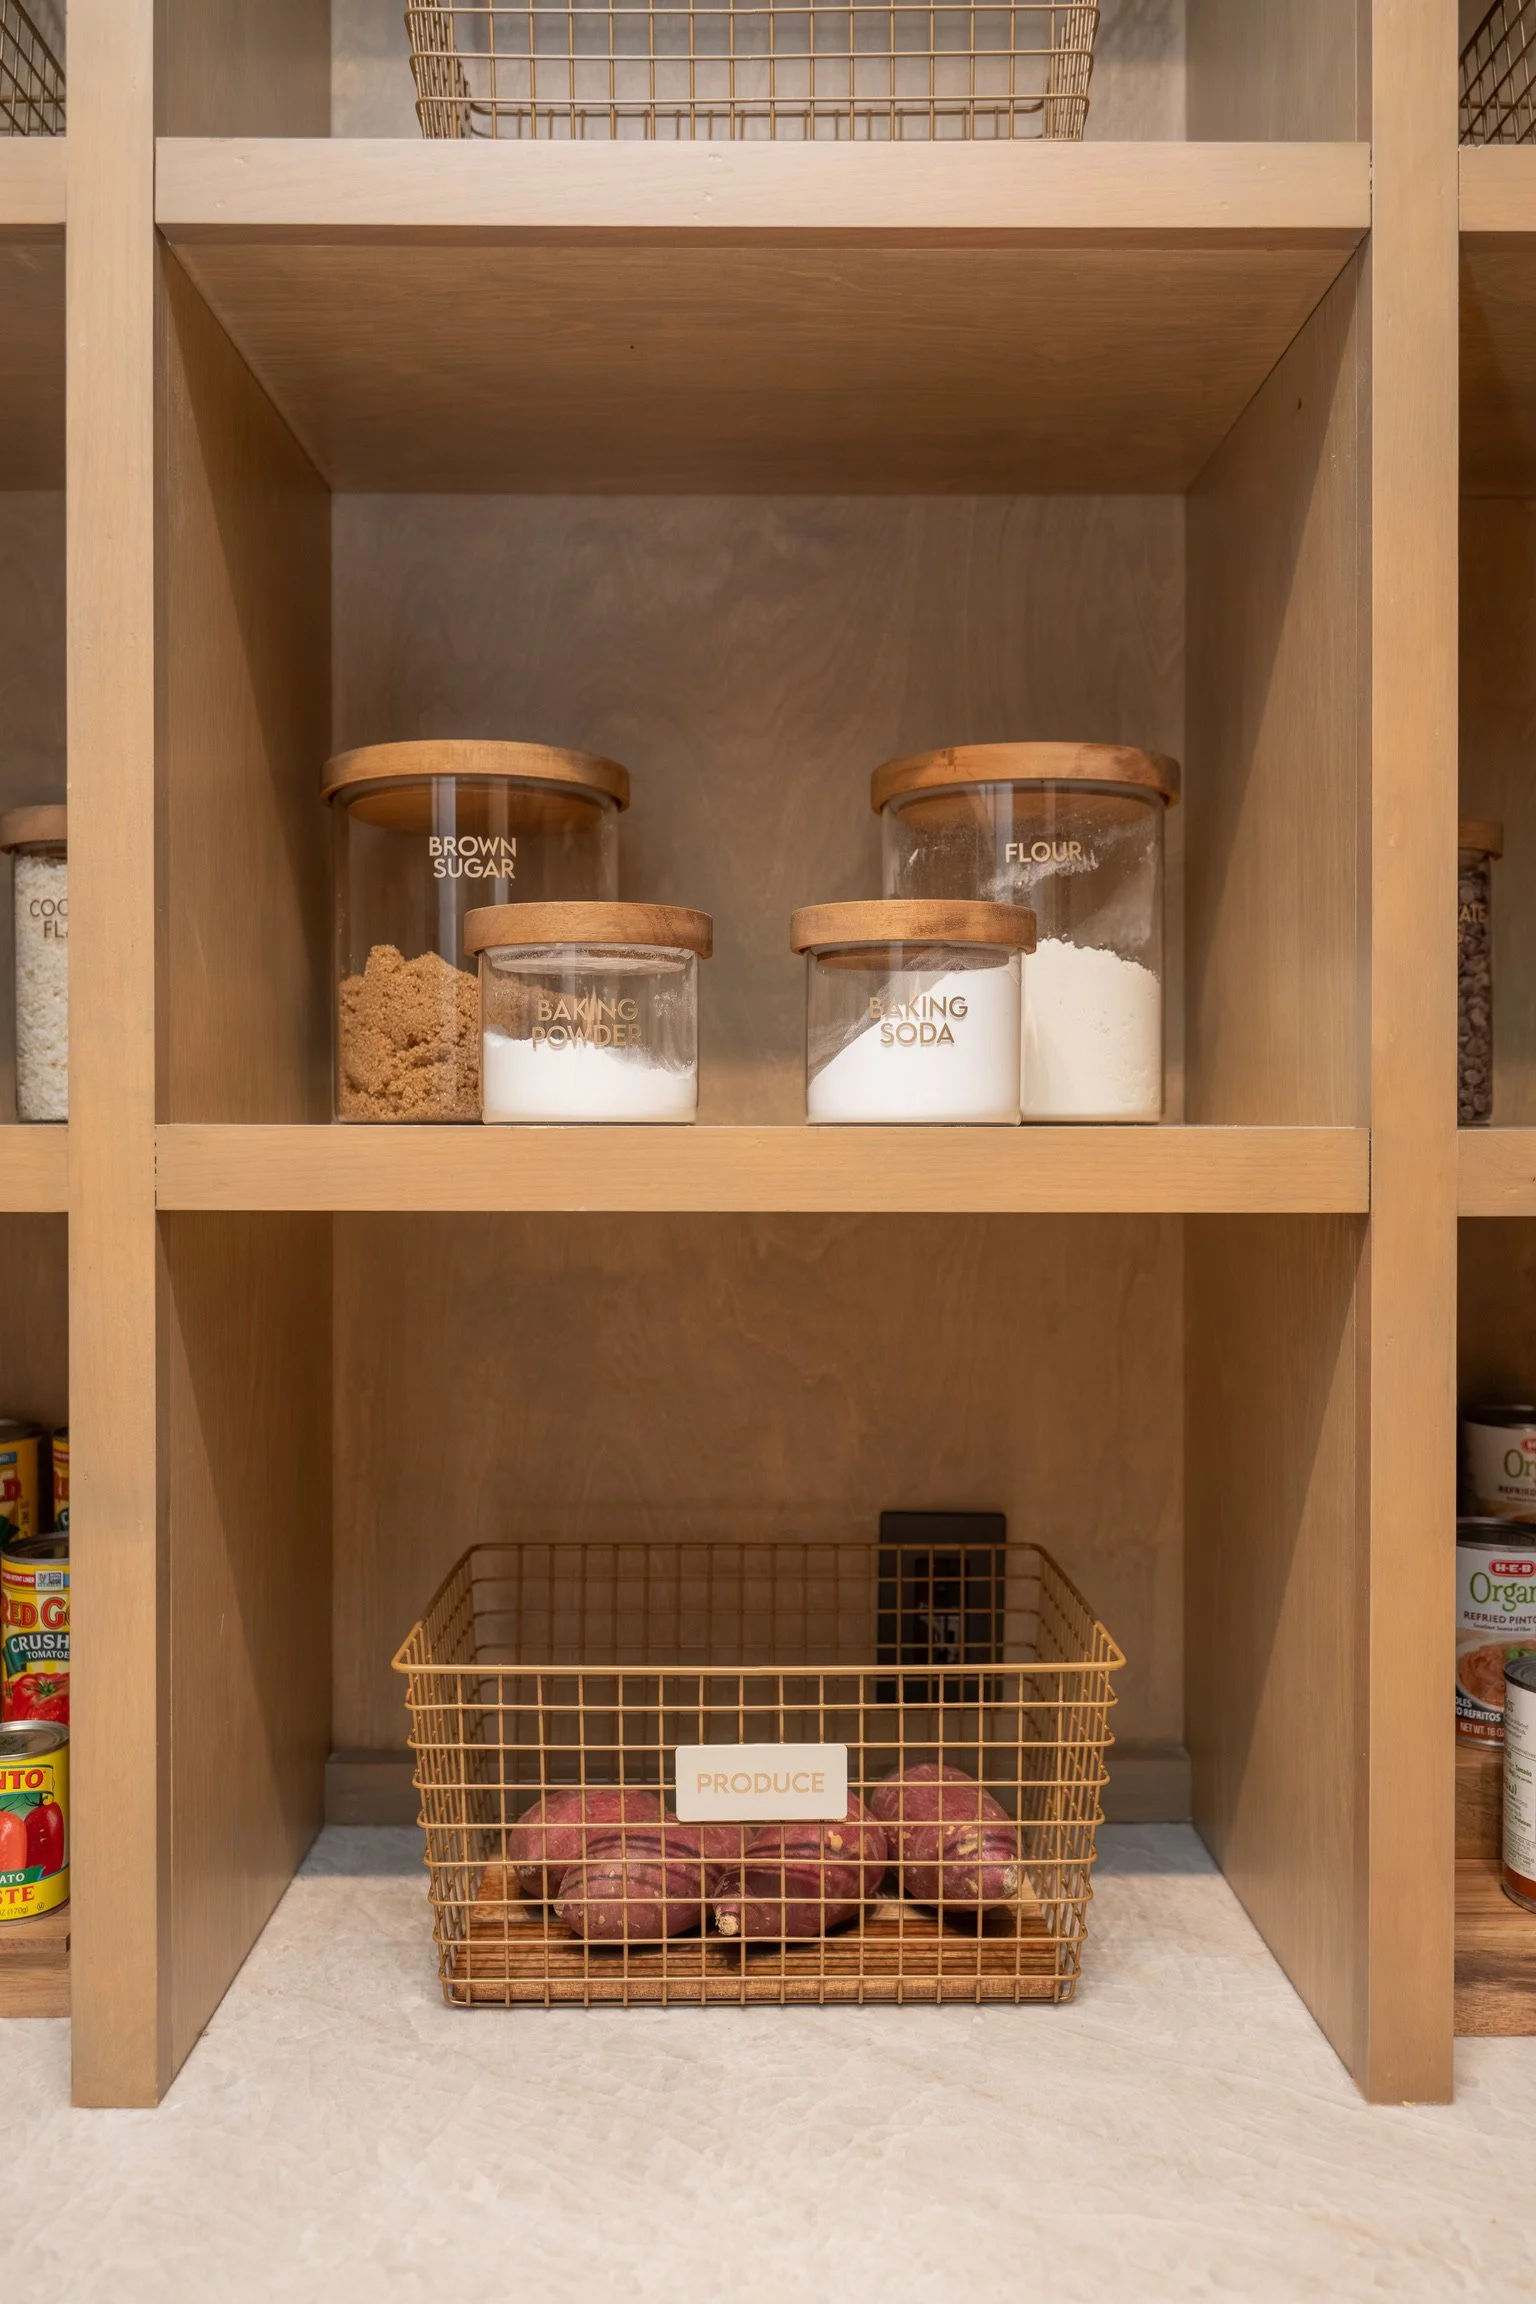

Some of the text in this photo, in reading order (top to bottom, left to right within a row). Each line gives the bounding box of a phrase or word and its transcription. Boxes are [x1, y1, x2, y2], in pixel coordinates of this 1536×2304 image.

[429, 836, 517, 857] BROWN
[1006, 841, 1082, 863] FLOUR
[433, 858, 515, 879] SUGAR
[44, 920, 68, 938] FL
[538, 998, 639, 1020] BAKING
[869, 996, 968, 1019] BAKING
[532, 1024, 641, 1050] POWDER
[880, 1022, 954, 1046] SODA
[1504, 1449, 1536, 1478] Or
[41, 1597, 69, 1630] G
[1464, 1611, 1507, 1624] REFRIED
[1463, 1708, 1502, 1722] REFRITOS
[697, 1772, 826, 1794] PRODUCE
